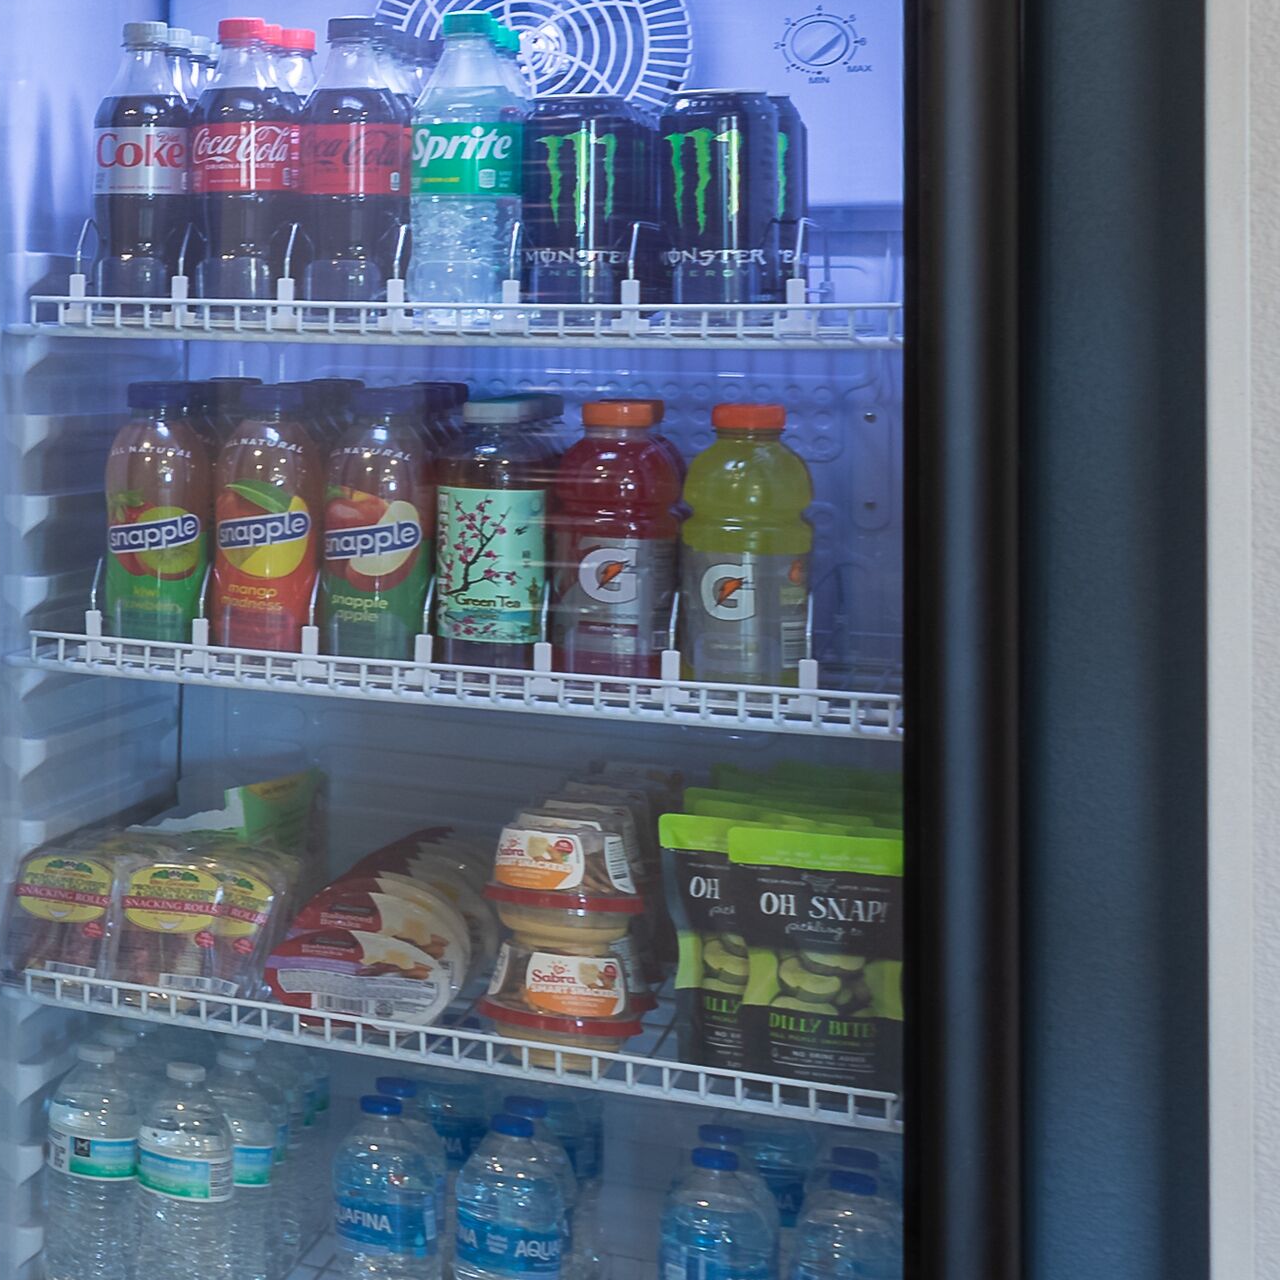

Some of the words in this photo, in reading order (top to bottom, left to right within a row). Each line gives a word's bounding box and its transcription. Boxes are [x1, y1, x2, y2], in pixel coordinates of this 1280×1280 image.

[846, 64, 873, 73] MAX
[808, 76, 831, 85] MIN
[97, 132, 186, 169] Coke
[411, 125, 513, 168] Sprite
[129, 445, 192, 459] NATURAL
[239, 437, 304, 454] NATURAL
[343, 446, 412, 462] NATURAL
[110, 516, 197, 549] snapple
[220, 513, 308, 546] snapple
[579, 547, 638, 604] G
[228, 583, 277, 601] mango
[454, 593, 496, 608] Green
[495, 595, 521, 608] Tea
[700, 563, 755, 620] G
[222, 595, 284, 612] madness
[331, 593, 389, 610] snapple
[334, 609, 379, 624] apple
[20, 886, 73, 900] SNACKING
[74, 892, 109, 907] ROLLS
[689, 876, 720, 900] OH
[125, 897, 182, 912] SNACKING
[183, 902, 219, 916] ROLLS
[760, 891, 797, 917] OH
[808, 895, 889, 923] SNAP!
[531, 968, 577, 984] Sabra
[704, 996, 740, 1014] ILLY
[769, 1012, 821, 1033] DILLY
[336, 1207, 393, 1234] UAFINA
